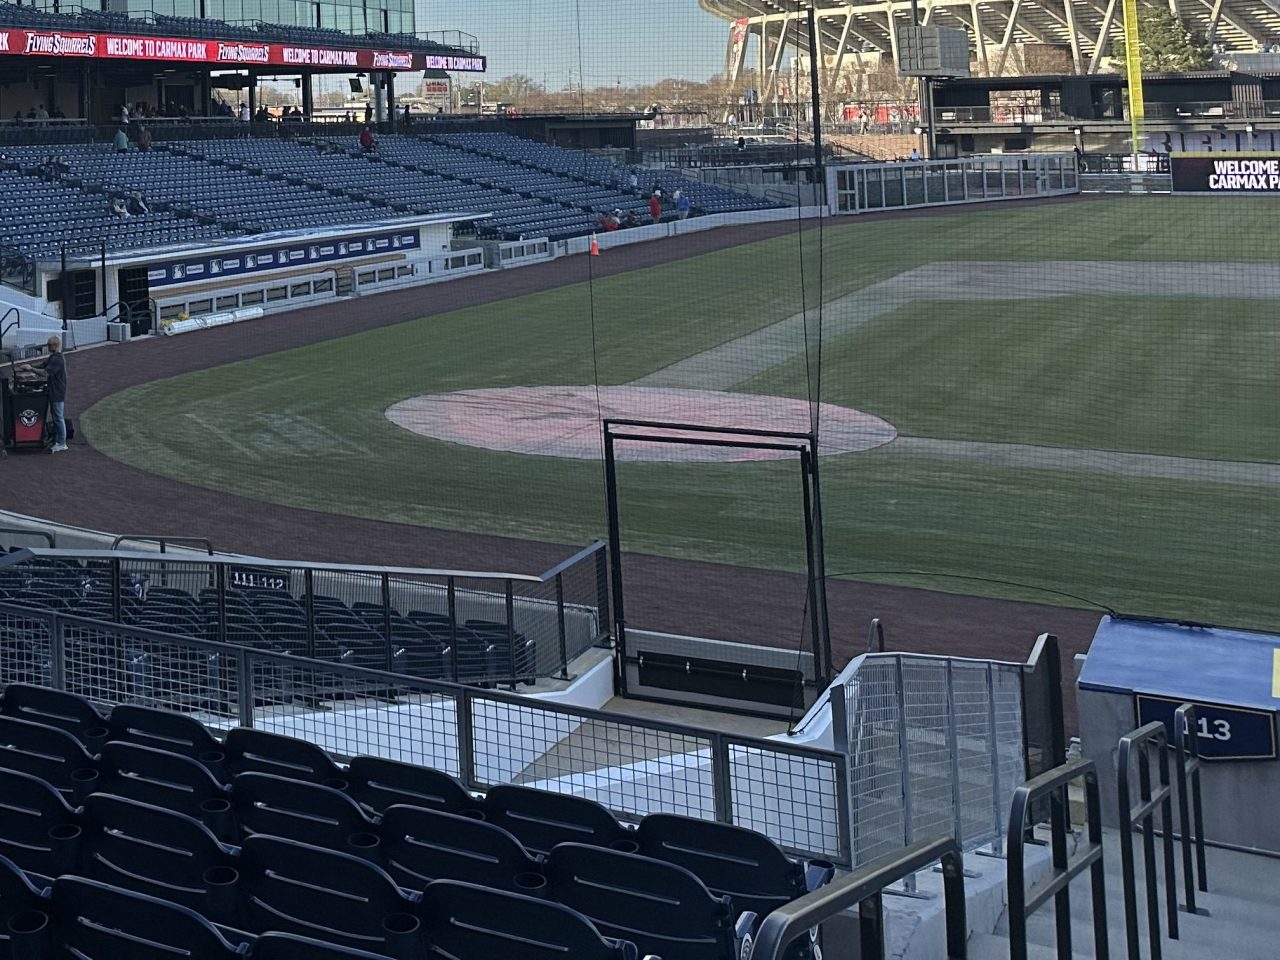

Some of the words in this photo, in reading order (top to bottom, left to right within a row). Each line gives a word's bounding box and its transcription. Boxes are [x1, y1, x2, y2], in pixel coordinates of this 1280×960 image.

[106, 38, 144, 56] WELCOME
[145, 40, 155, 57] TO
[156, 41, 187, 58] CARMAX
[188, 43, 207, 59] PARK
[282, 48, 311, 64] WELCOME
[311, 50, 319, 64] TO
[320, 50, 342, 65] CARMAX
[343, 51, 358, 66] PARK
[1213, 160, 1279, 175] WELCOME
[1209, 174, 1268, 189] CARMAX
[1269, 174, 1280, 189] P
